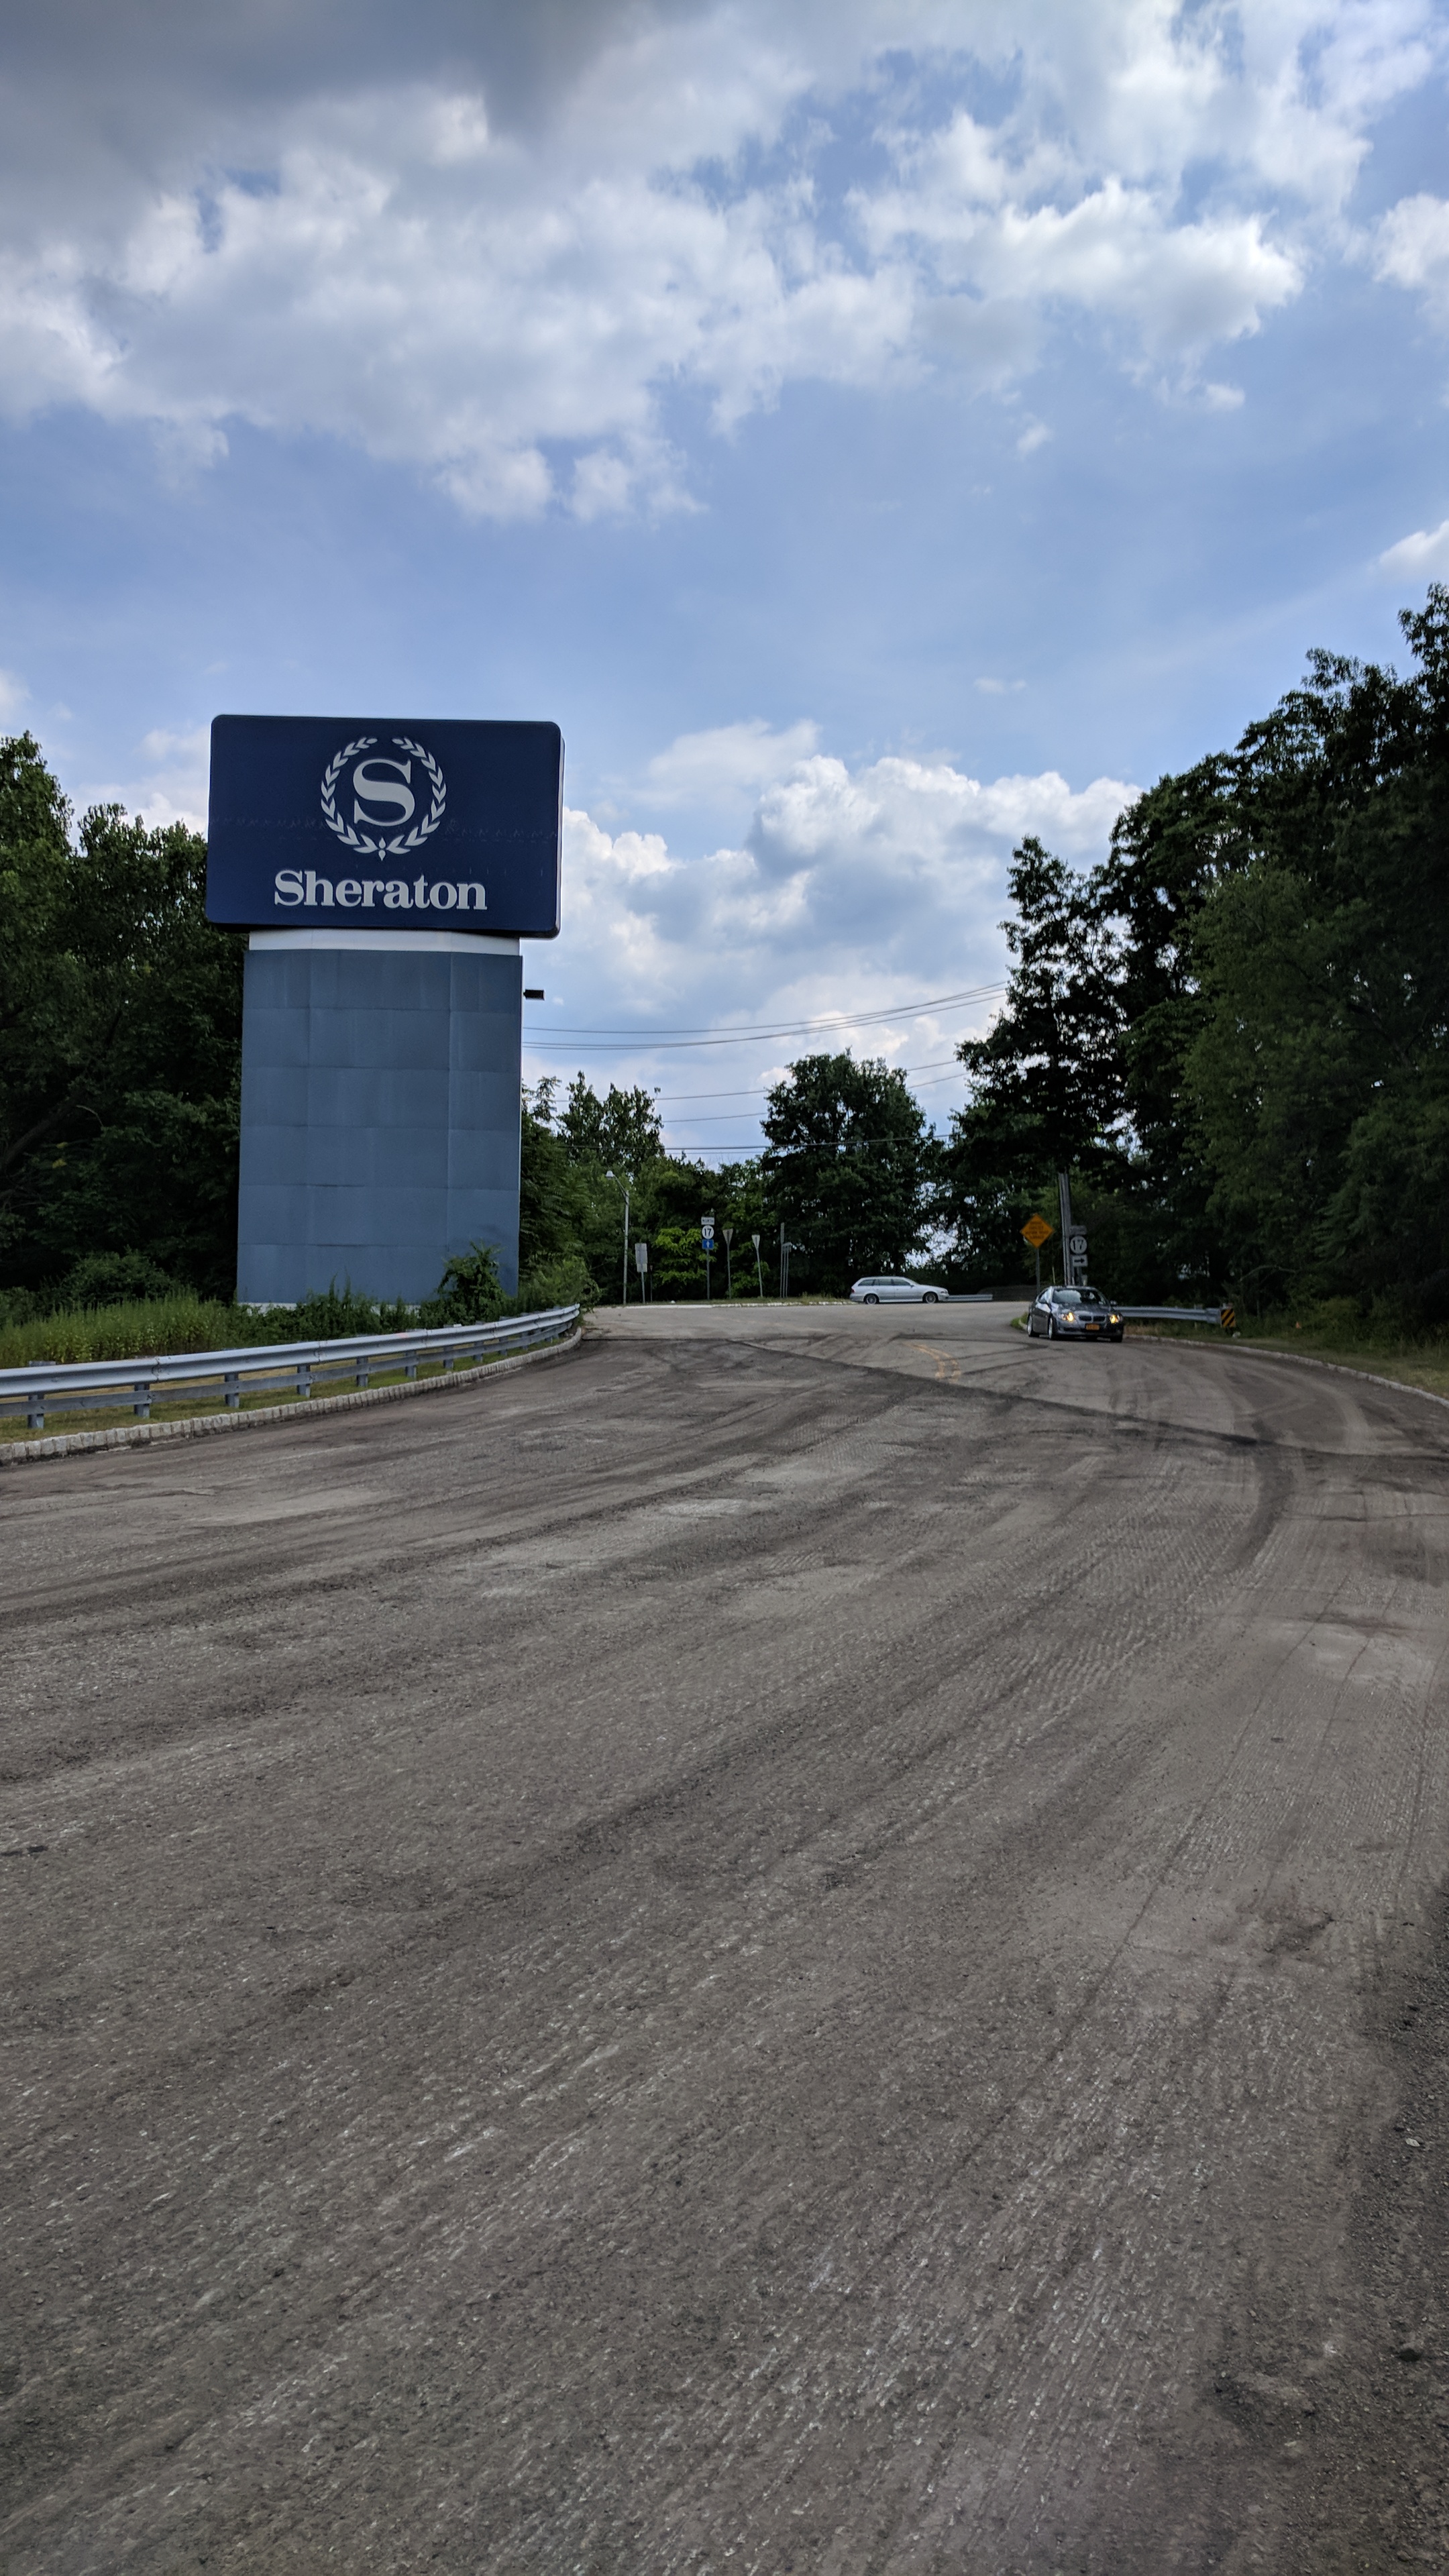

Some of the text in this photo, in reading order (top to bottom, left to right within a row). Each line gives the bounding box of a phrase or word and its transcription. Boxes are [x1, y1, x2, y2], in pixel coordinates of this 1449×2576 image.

[353, 758, 415, 826] S
[274, 869, 488, 910] Sheraton
[704, 1228, 712, 1236] 17
[1073, 1240, 1084, 1250] 17
